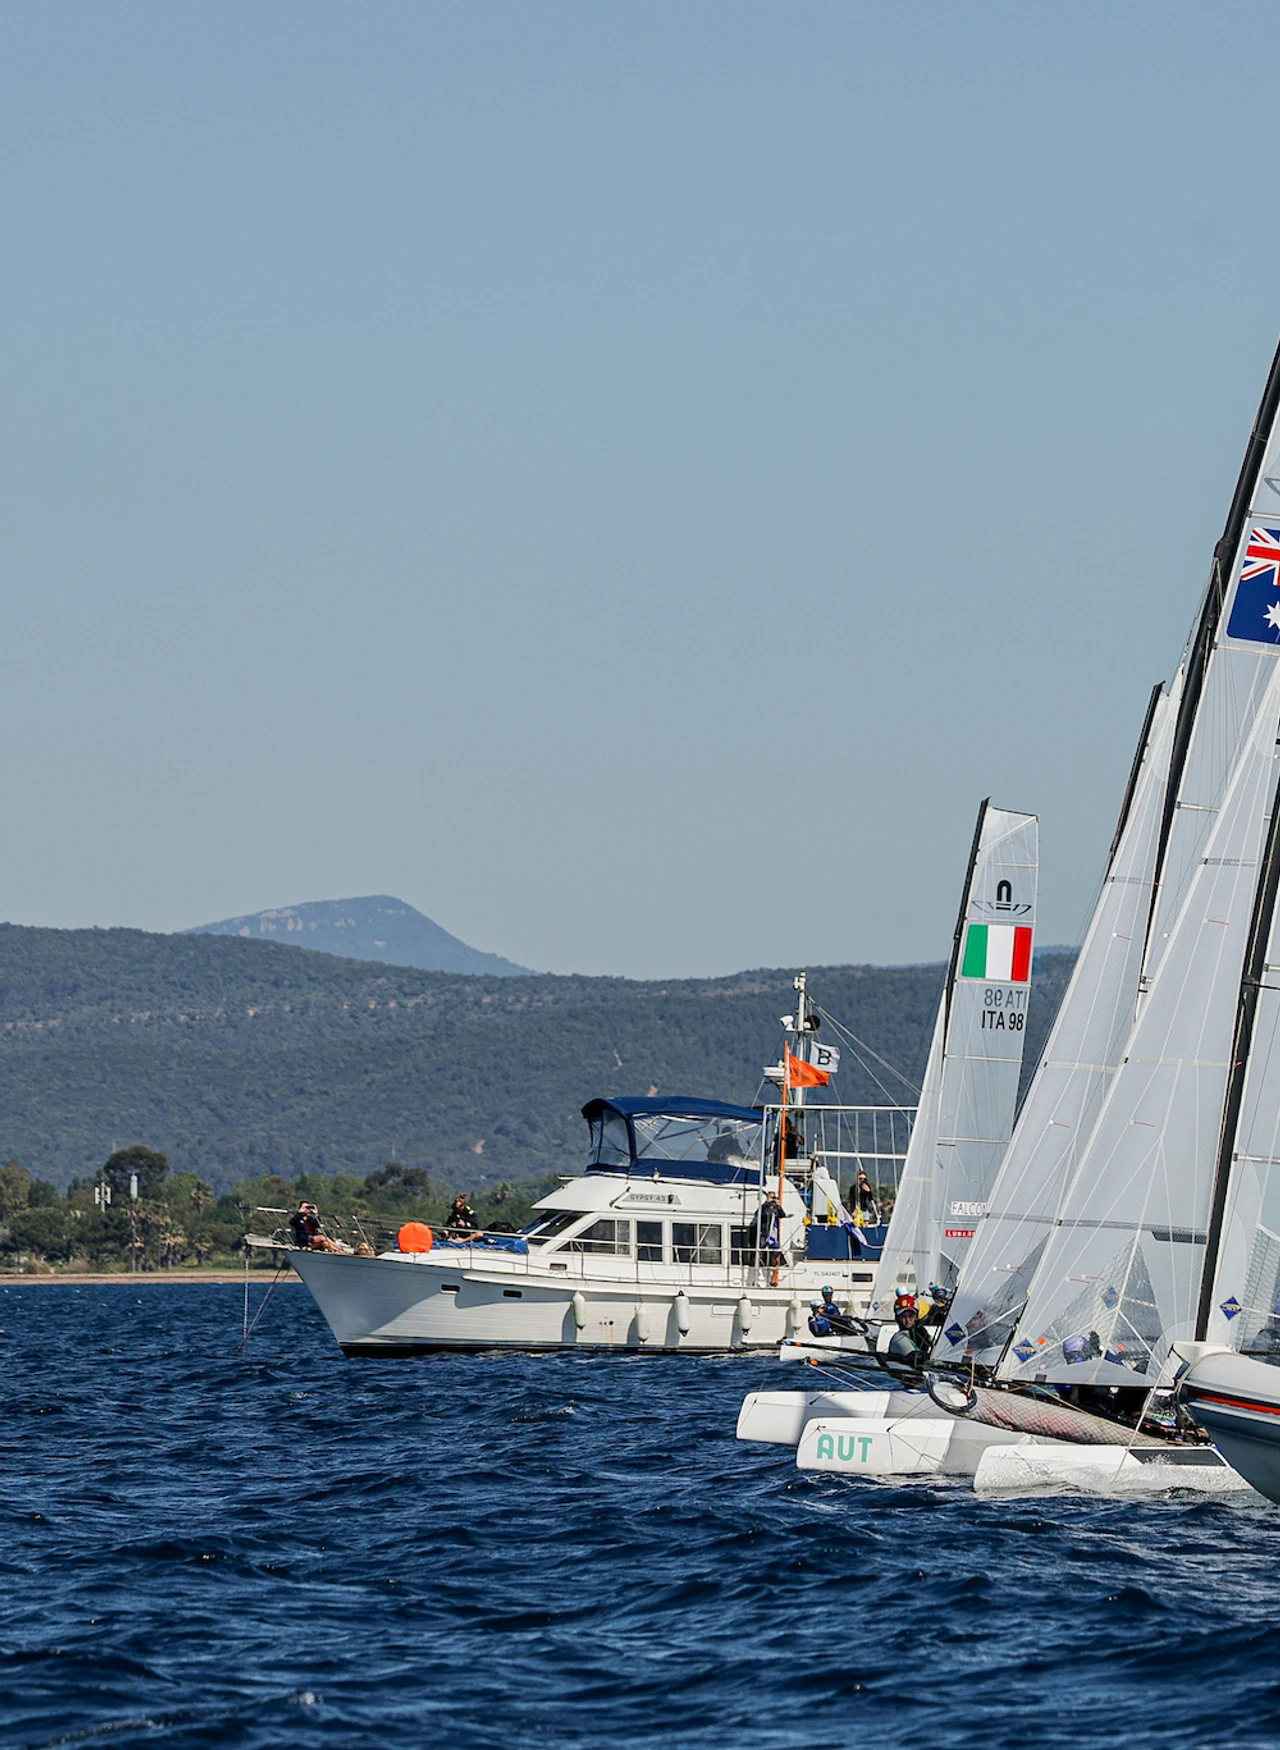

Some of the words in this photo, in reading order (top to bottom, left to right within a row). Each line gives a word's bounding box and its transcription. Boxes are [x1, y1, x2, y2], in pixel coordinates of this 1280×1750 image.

[817, 1048, 832, 1065] B
[952, 1202, 986, 1215] FALCO
[817, 1434, 873, 1463] AUT
